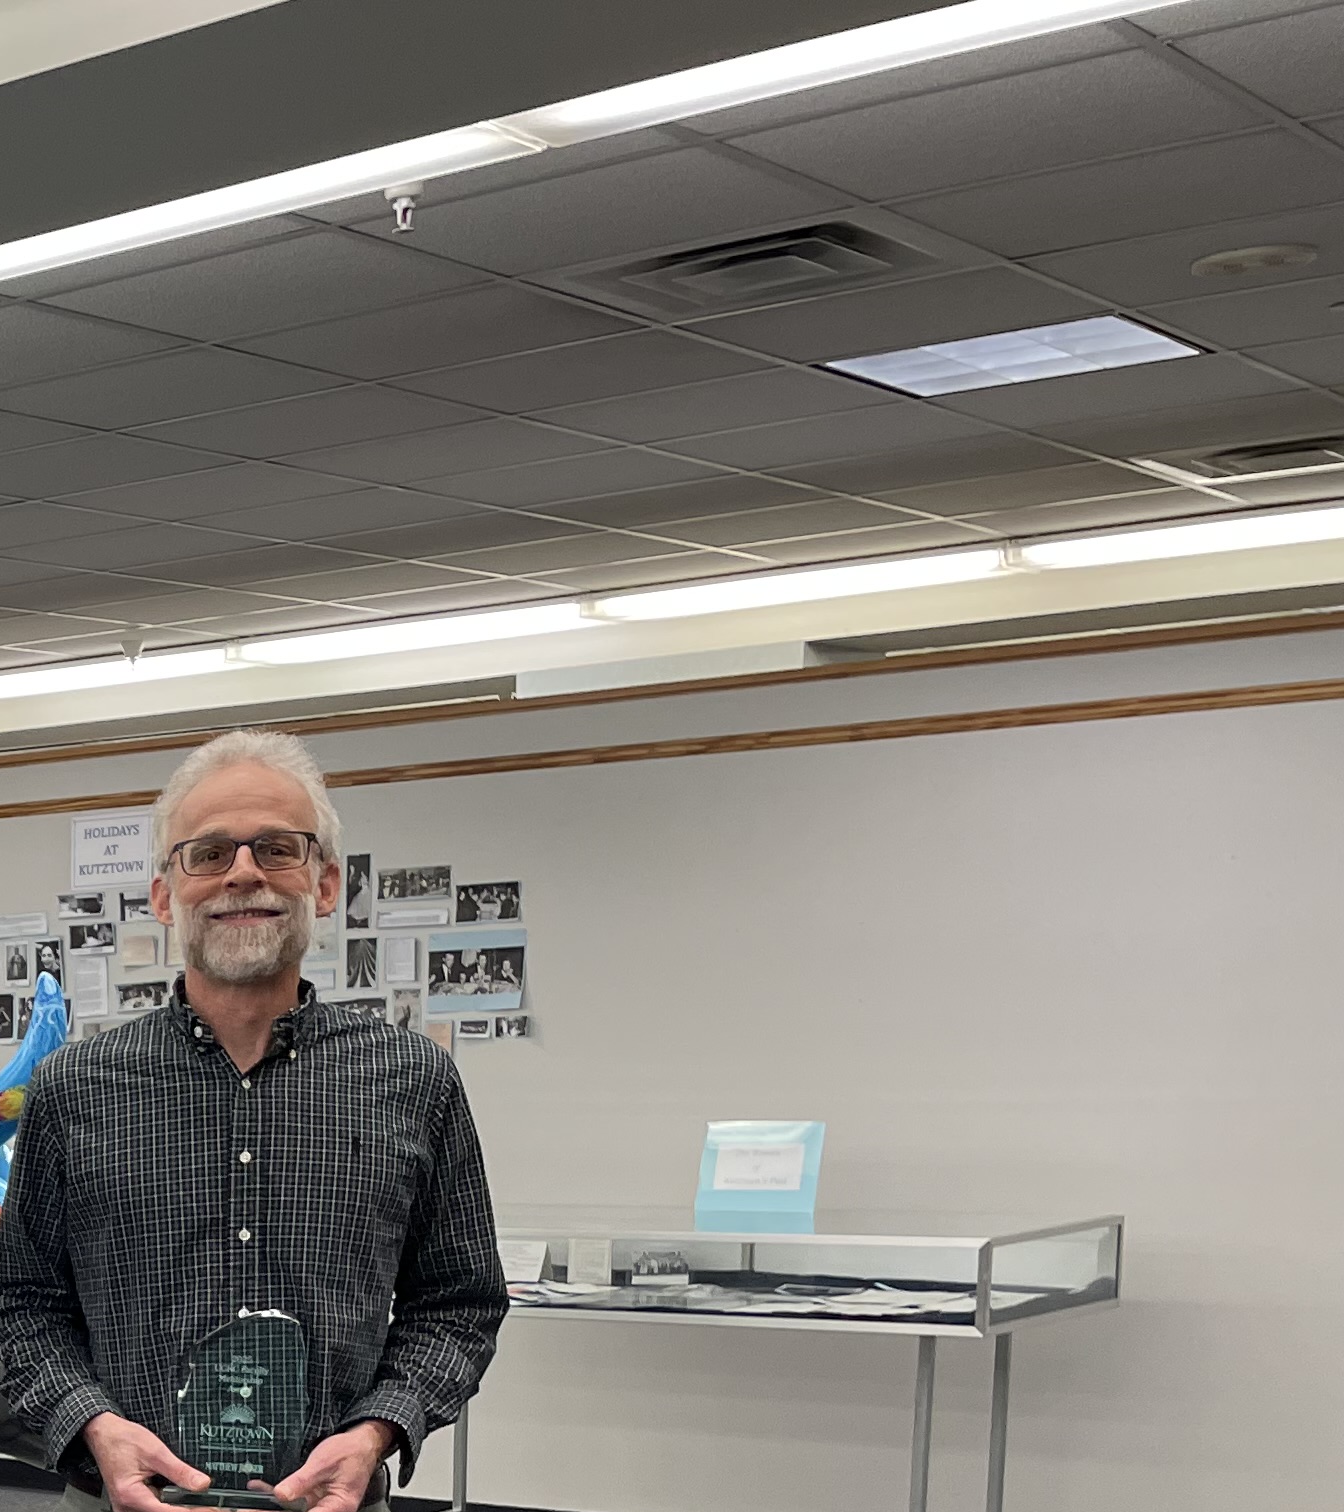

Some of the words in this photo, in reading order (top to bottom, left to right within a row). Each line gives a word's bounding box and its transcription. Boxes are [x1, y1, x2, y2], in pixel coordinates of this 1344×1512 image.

[83, 824, 140, 840] HOLIDAYS
[103, 844, 119, 856] AT
[78, 860, 144, 876] KUTZTOWN
[200, 1423, 274, 1440] KUTZTOWN
